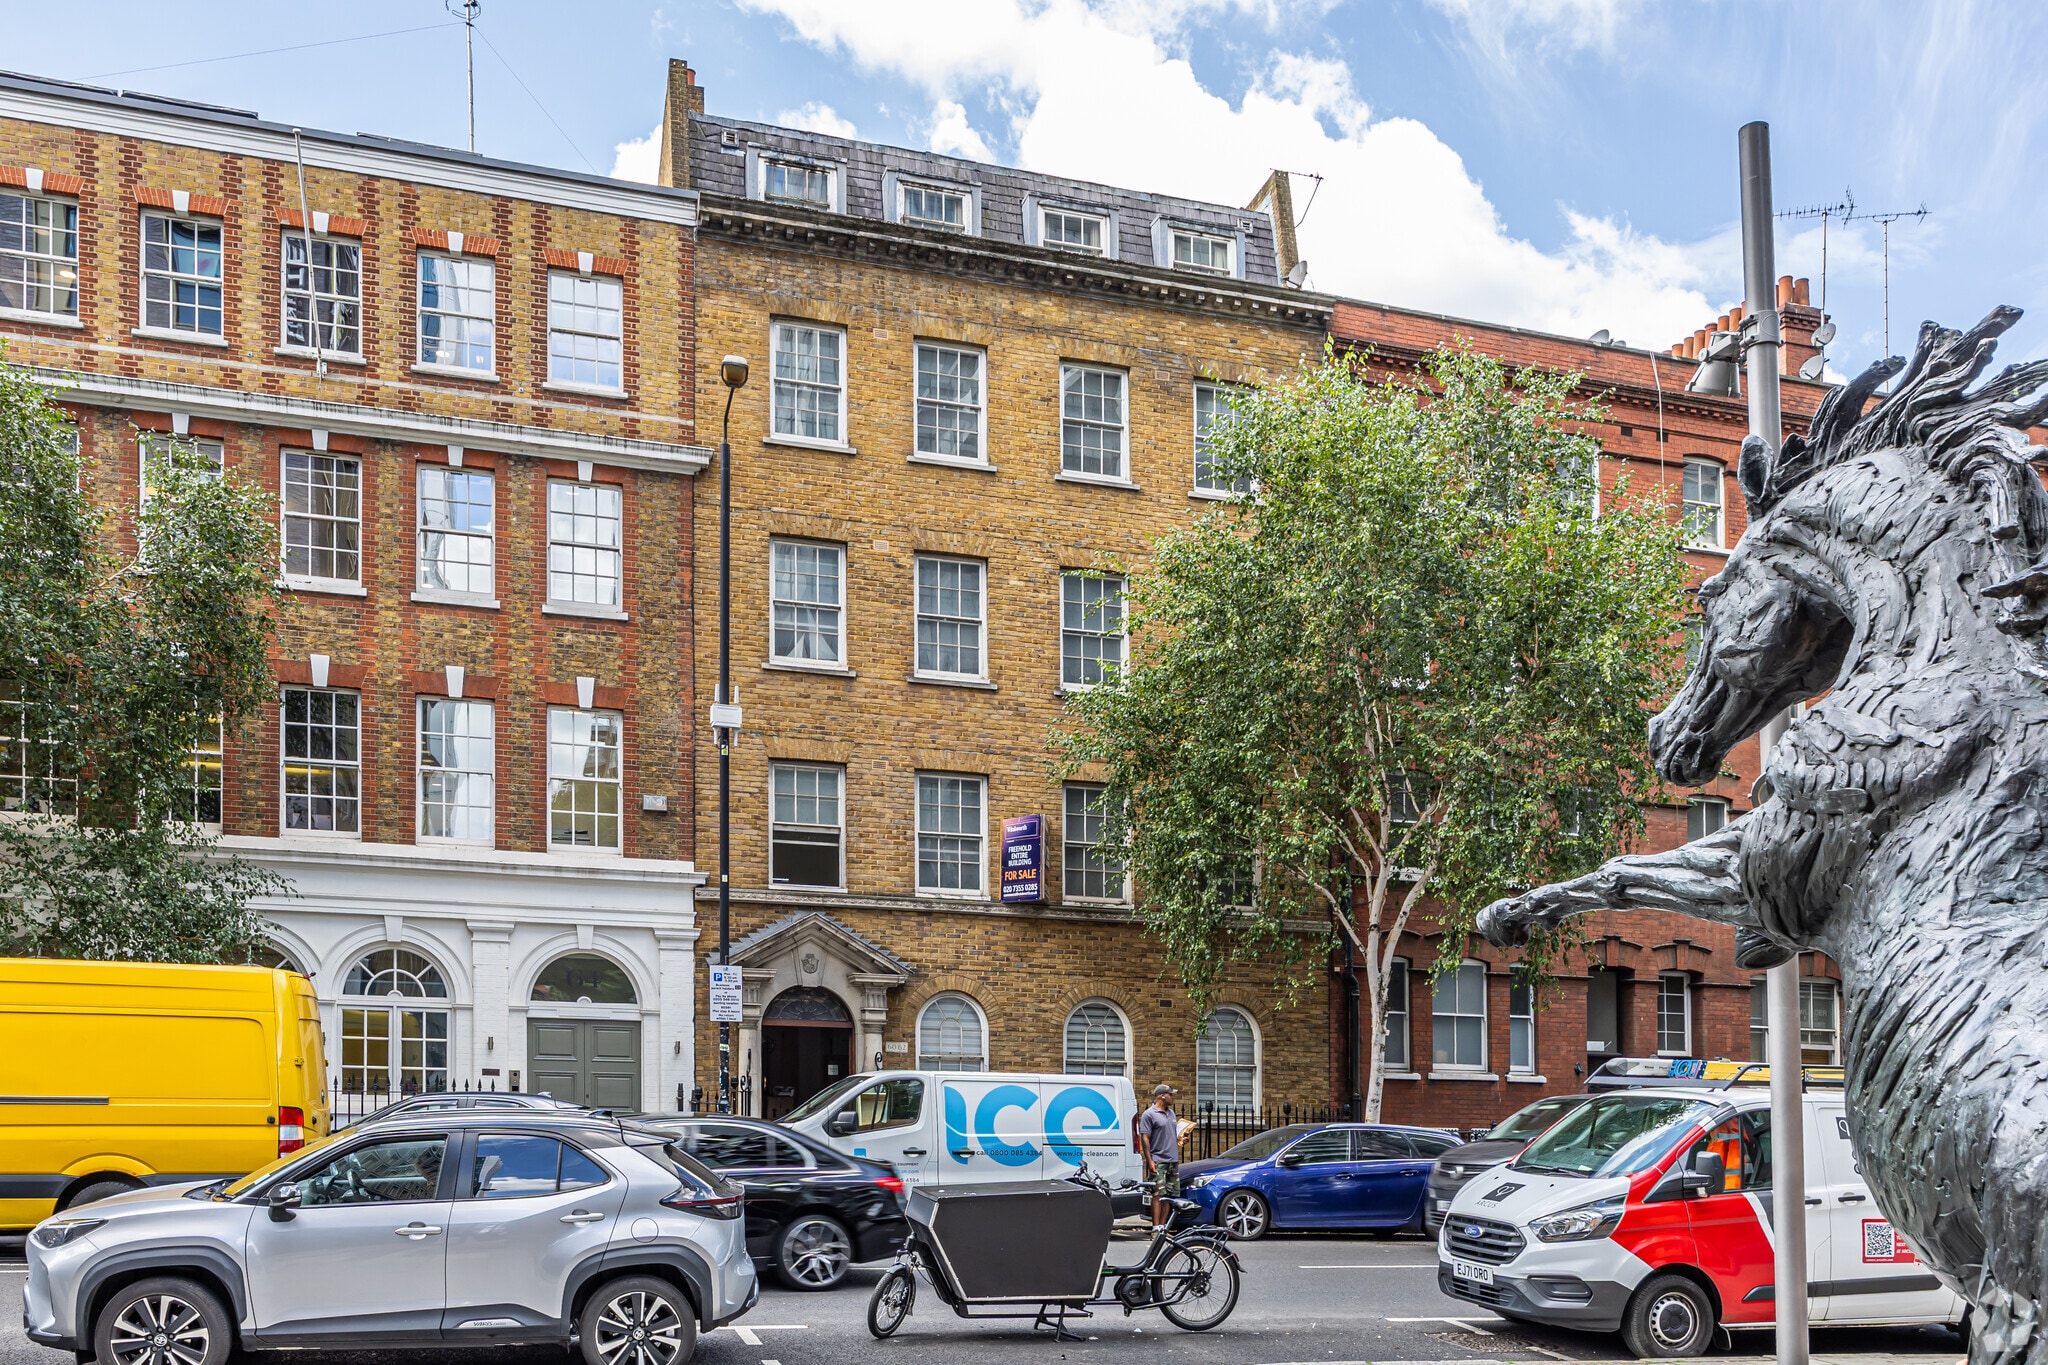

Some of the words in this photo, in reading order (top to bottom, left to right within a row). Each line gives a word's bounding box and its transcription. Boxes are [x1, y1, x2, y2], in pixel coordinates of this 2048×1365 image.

[1008, 845, 1032, 853] FREEHOLD
[1011, 852, 1028, 860] ENTIRE
[1008, 858, 1032, 867] BUILDING
[1004, 870, 1018, 880] FOR
[1018, 868, 1037, 880] SALE
[1003, 885, 1013, 893] 020
[1012, 884, 1025, 892] 7355
[1024, 883, 1038, 891] 0285
[566, 969, 602, 989] 64
[887, 1043, 897, 1051] 60
[1475, 1200, 1499, 1208] ARCUS
[1457, 1263, 1473, 1278] EJ71
